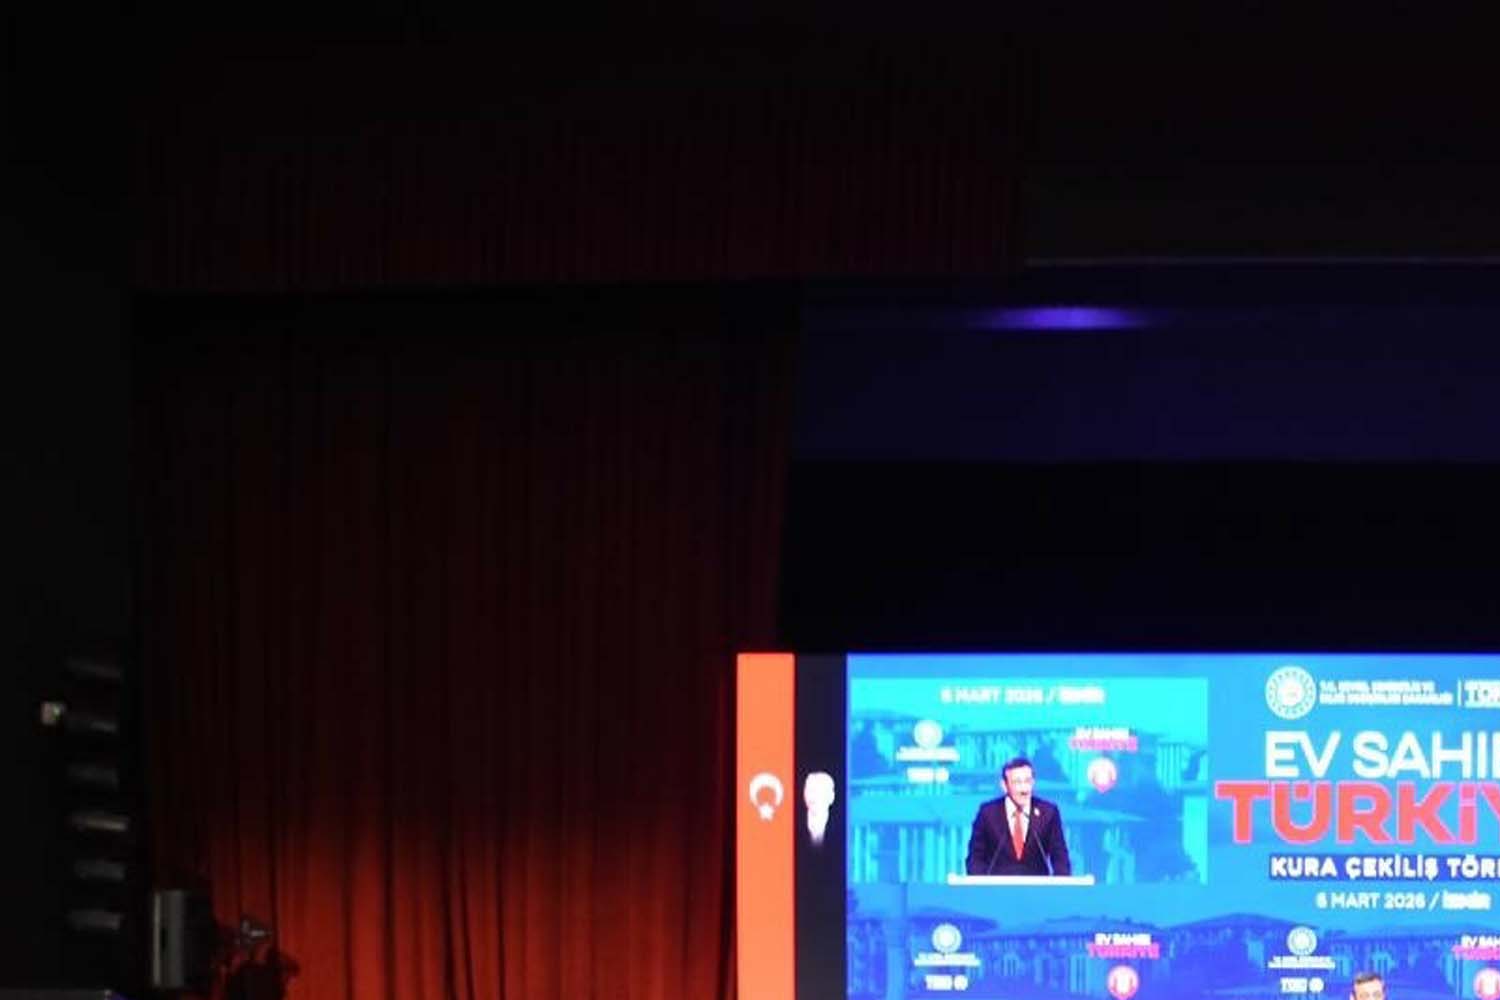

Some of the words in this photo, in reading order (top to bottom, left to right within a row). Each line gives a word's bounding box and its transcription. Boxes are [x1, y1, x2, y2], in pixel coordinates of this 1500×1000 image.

[1265, 730, 1341, 779] EV
[1270, 856, 1338, 877] KURA
[1345, 853, 1439, 880] ÇEKİLİŞ
[1330, 892, 1381, 909] MART
